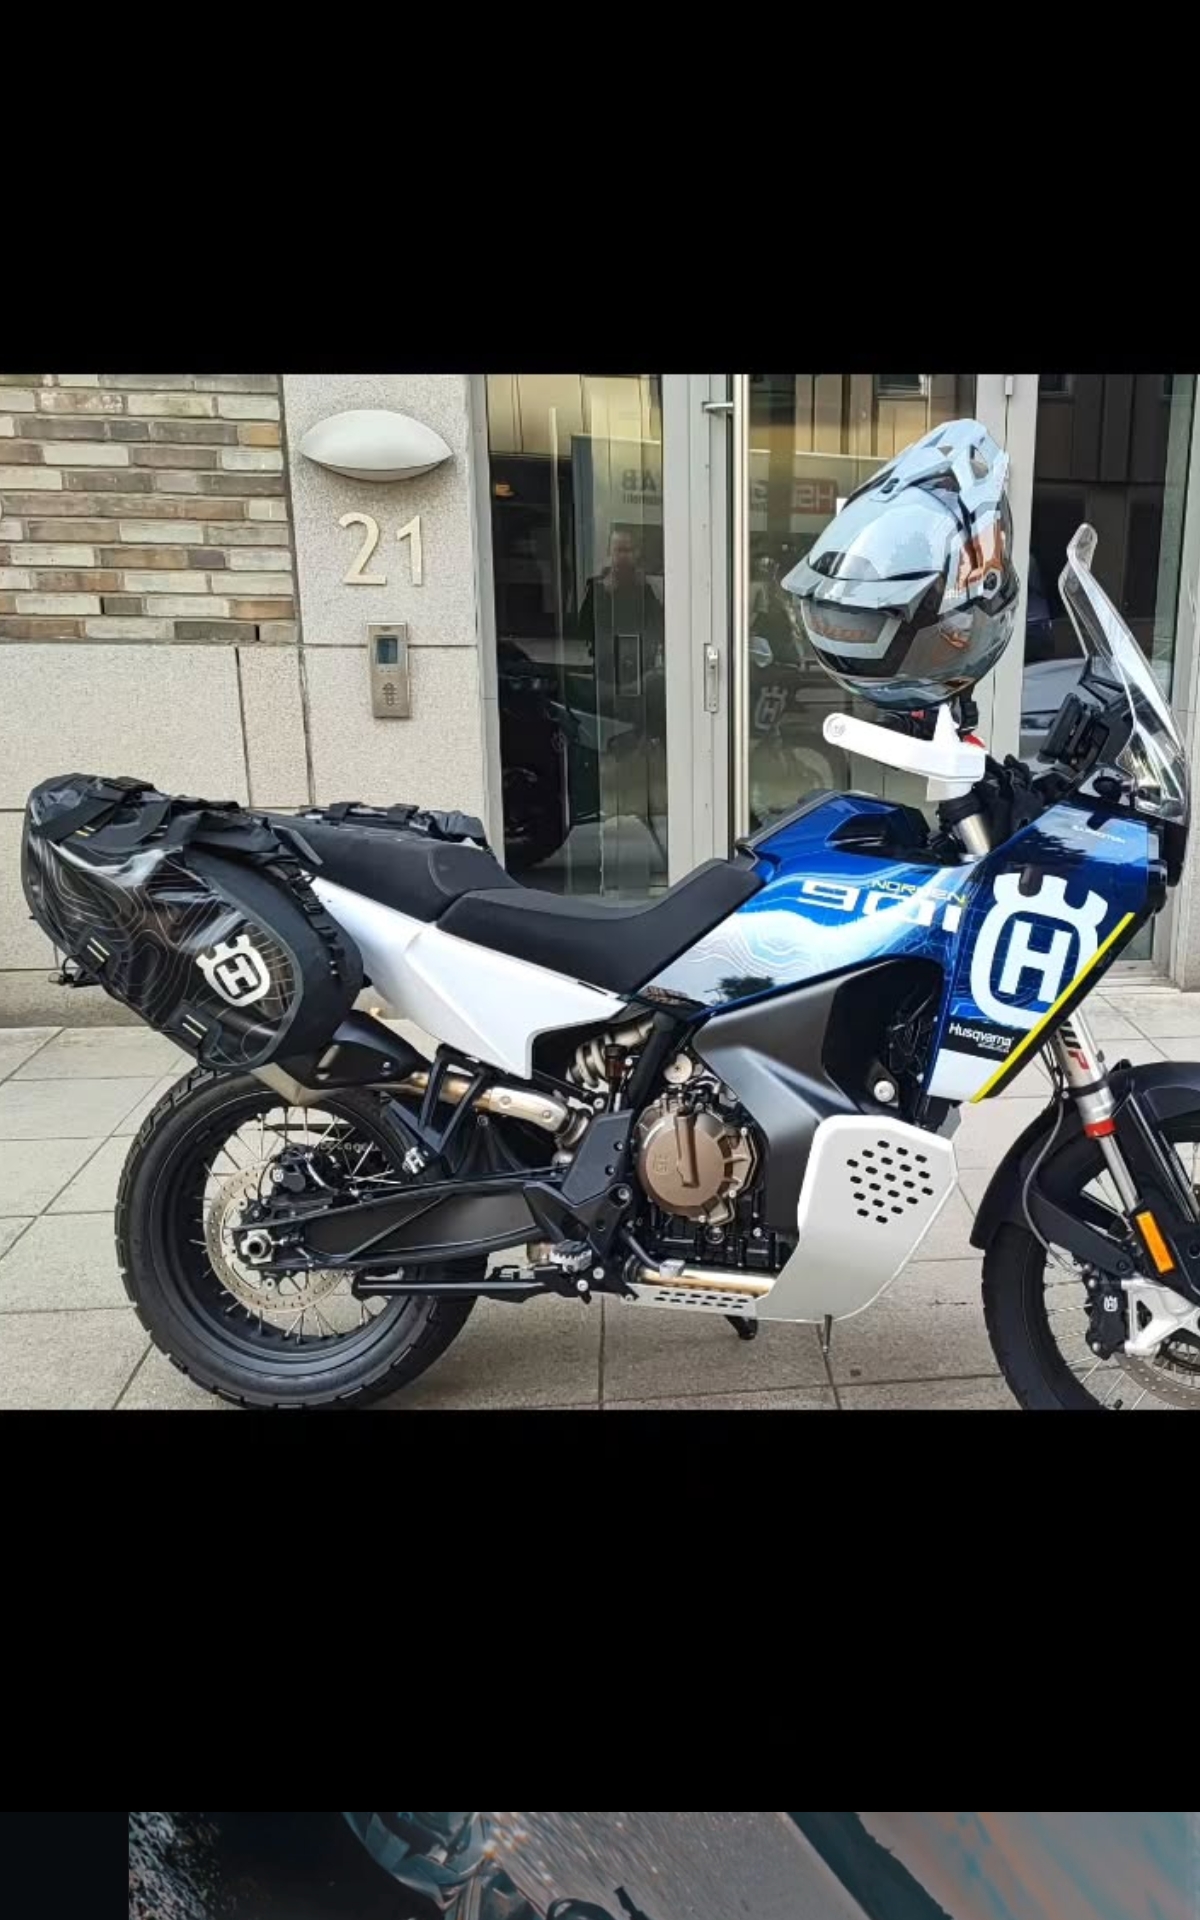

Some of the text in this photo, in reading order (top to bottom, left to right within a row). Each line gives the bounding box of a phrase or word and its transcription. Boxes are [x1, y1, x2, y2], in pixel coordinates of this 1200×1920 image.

[338, 511, 423, 586] 21
[797, 879, 962, 933] 901
[870, 879, 966, 906] NOREN
[948, 1022, 1012, 1046] Husqvarna
